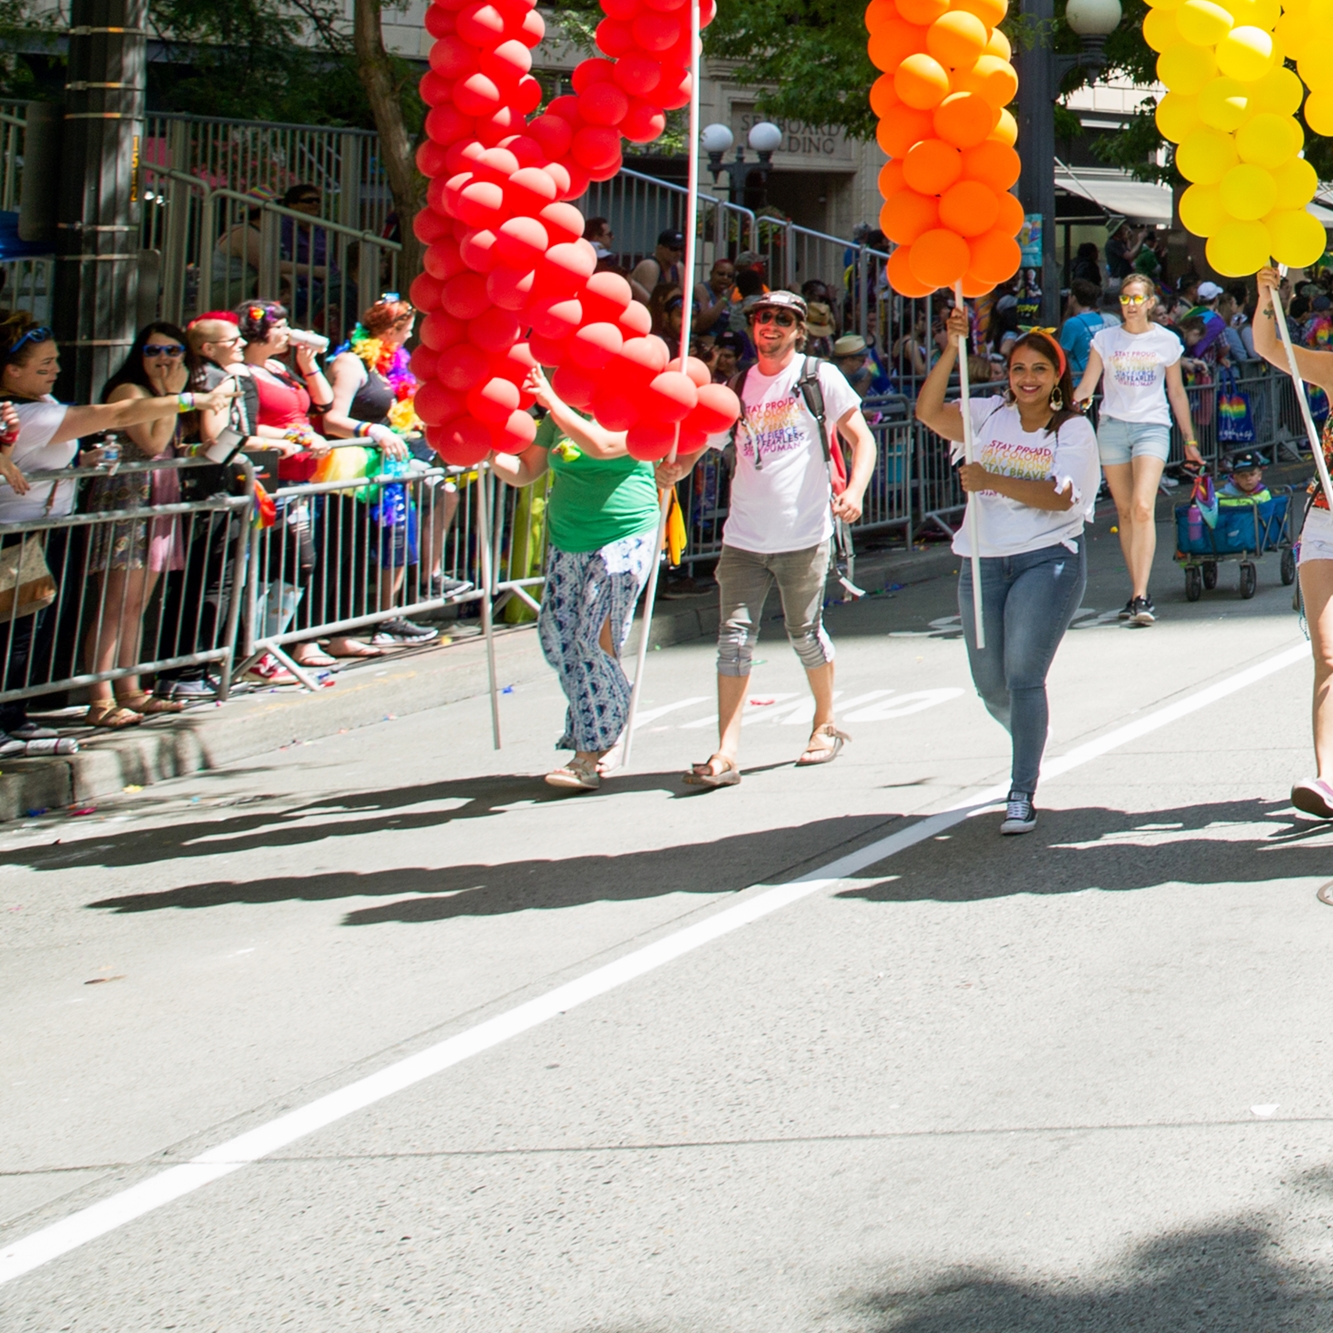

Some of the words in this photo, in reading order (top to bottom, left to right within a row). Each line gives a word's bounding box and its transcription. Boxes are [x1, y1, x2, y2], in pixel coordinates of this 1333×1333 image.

[768, 426, 798, 439] FIERCE
[763, 432, 805, 447] FEARLESS
[990, 439, 1015, 451] STAY
[1015, 444, 1052, 457] PROUD
[1007, 458, 1051, 471] STRONG
[1009, 467, 1046, 479] BRAVE
